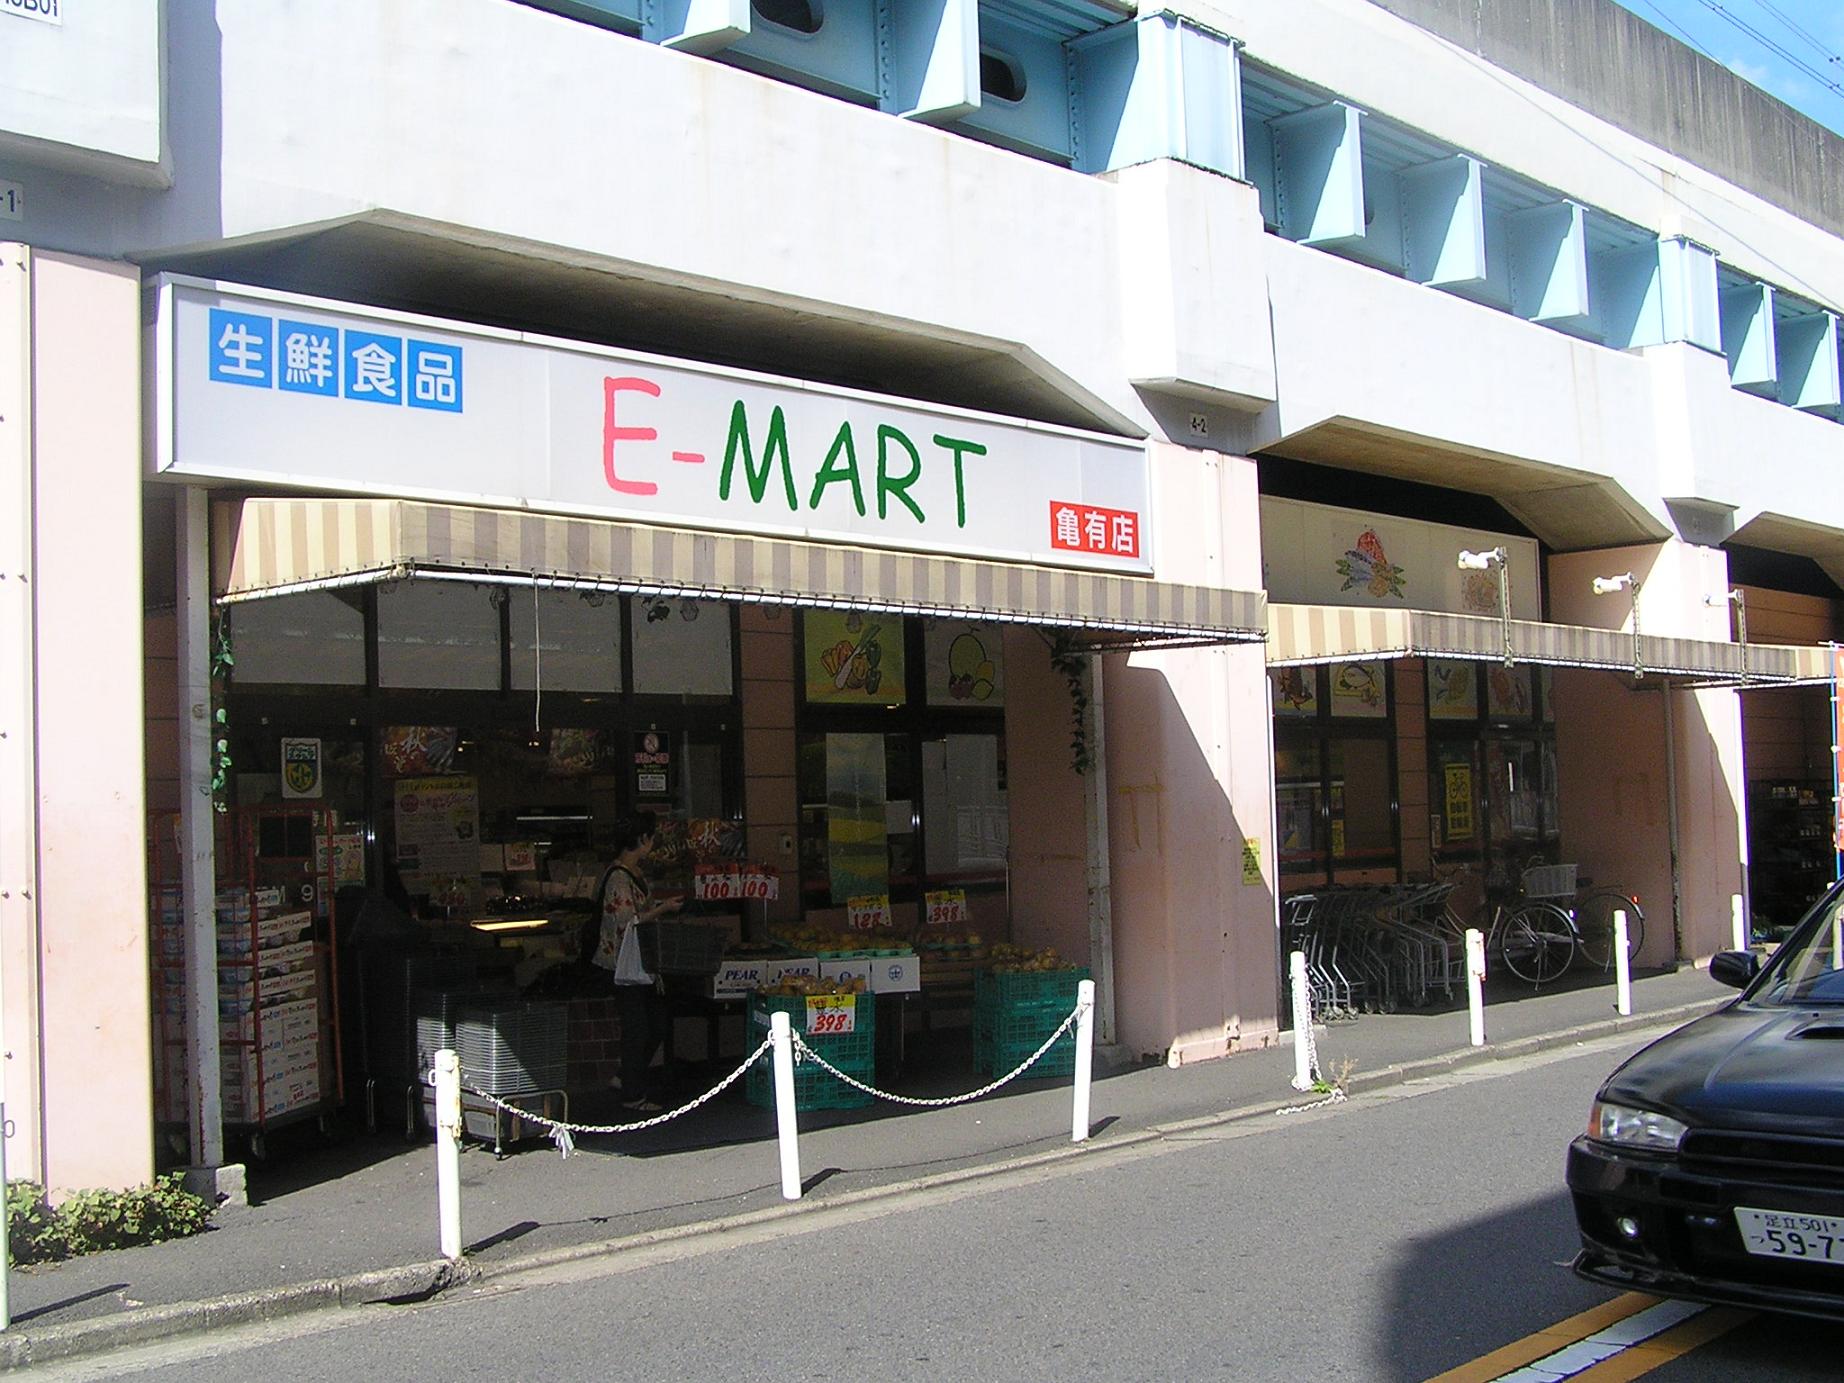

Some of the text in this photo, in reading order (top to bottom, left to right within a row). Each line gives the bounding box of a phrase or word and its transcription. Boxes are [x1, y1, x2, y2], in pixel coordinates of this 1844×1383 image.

[218, 323, 456, 404] 生鮮食品
[1191, 417, 1206, 433] 4-2
[603, 375, 987, 528] E-MART
[1056, 506, 1134, 554] 亀有店
[704, 882, 730, 899] 100
[725, 969, 758, 980] PEAR
[814, 1013, 848, 1032] 398
[1766, 1229, 1844, 1258] 59-7
